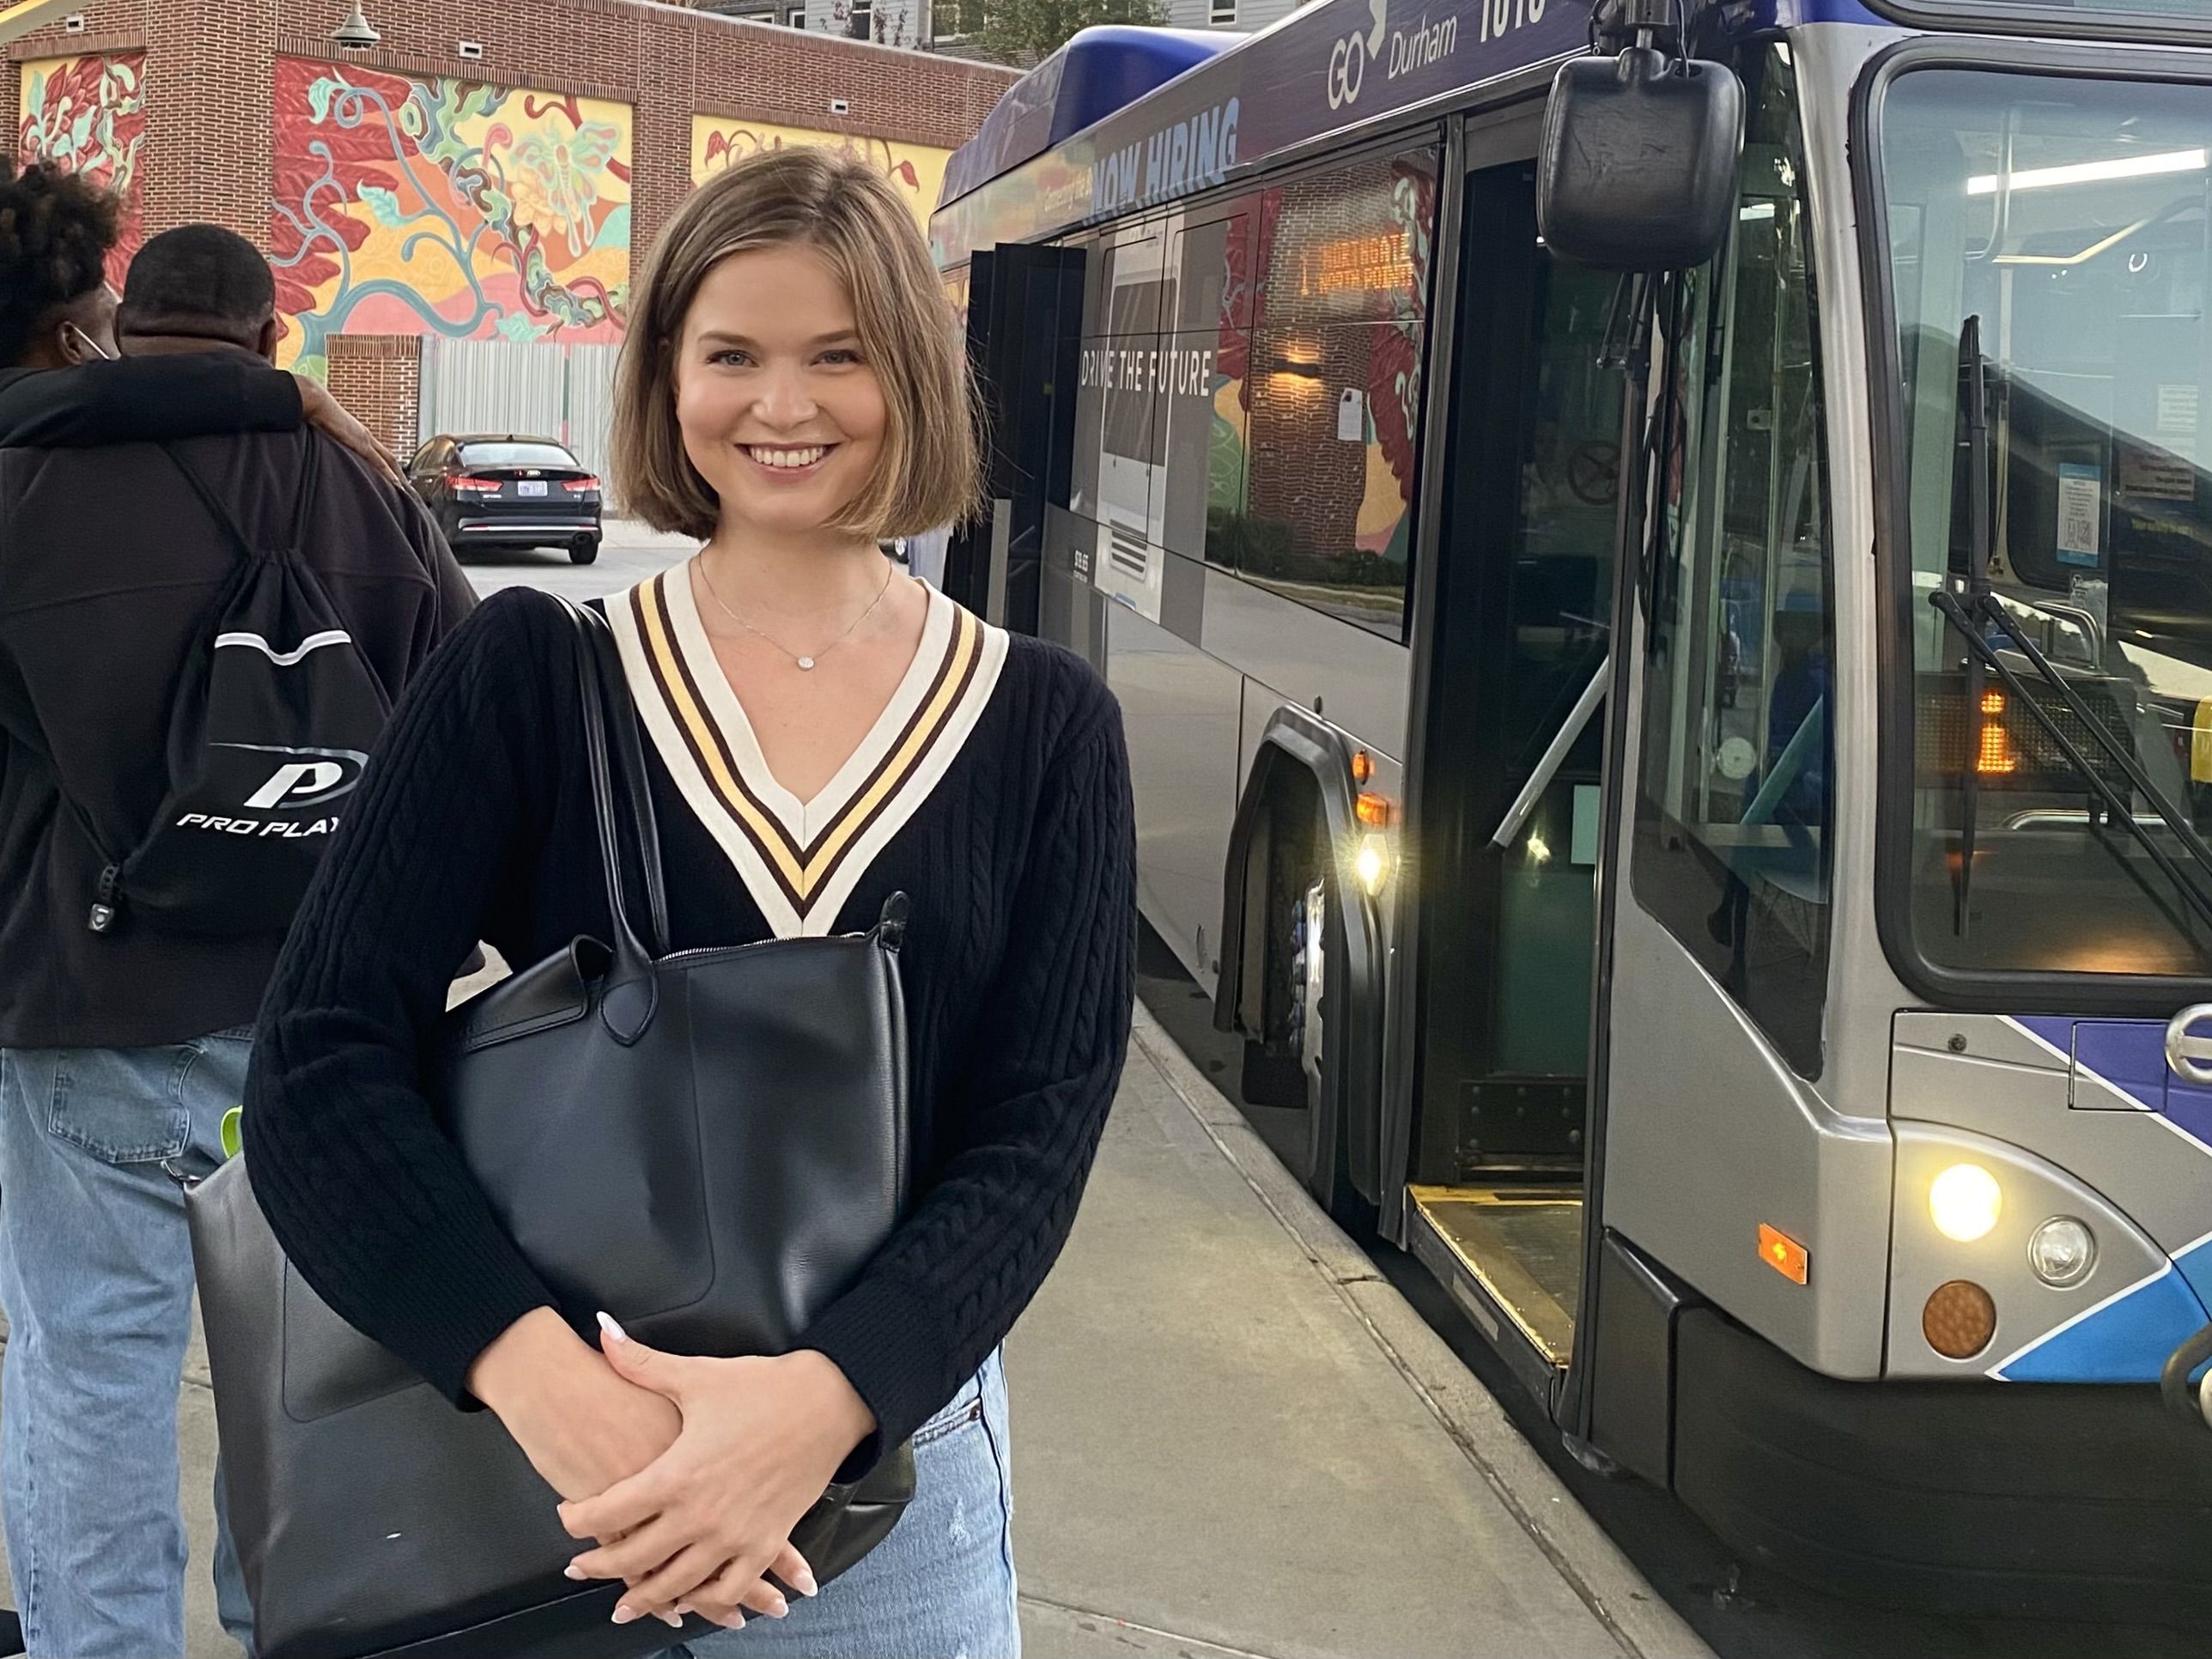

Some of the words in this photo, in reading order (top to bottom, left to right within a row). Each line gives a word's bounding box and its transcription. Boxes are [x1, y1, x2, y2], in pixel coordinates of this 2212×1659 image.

[1328, 30, 1364, 111] GO
[1388, 14, 1457, 81] Durham
[1091, 142, 1141, 215] NOW
[1145, 97, 1239, 195] HIRING
[1081, 350, 1115, 389] DRIVE
[1119, 350, 1144, 391] THE
[1147, 350, 1212, 396] FUTURE
[176, 812, 260, 836] PRO
